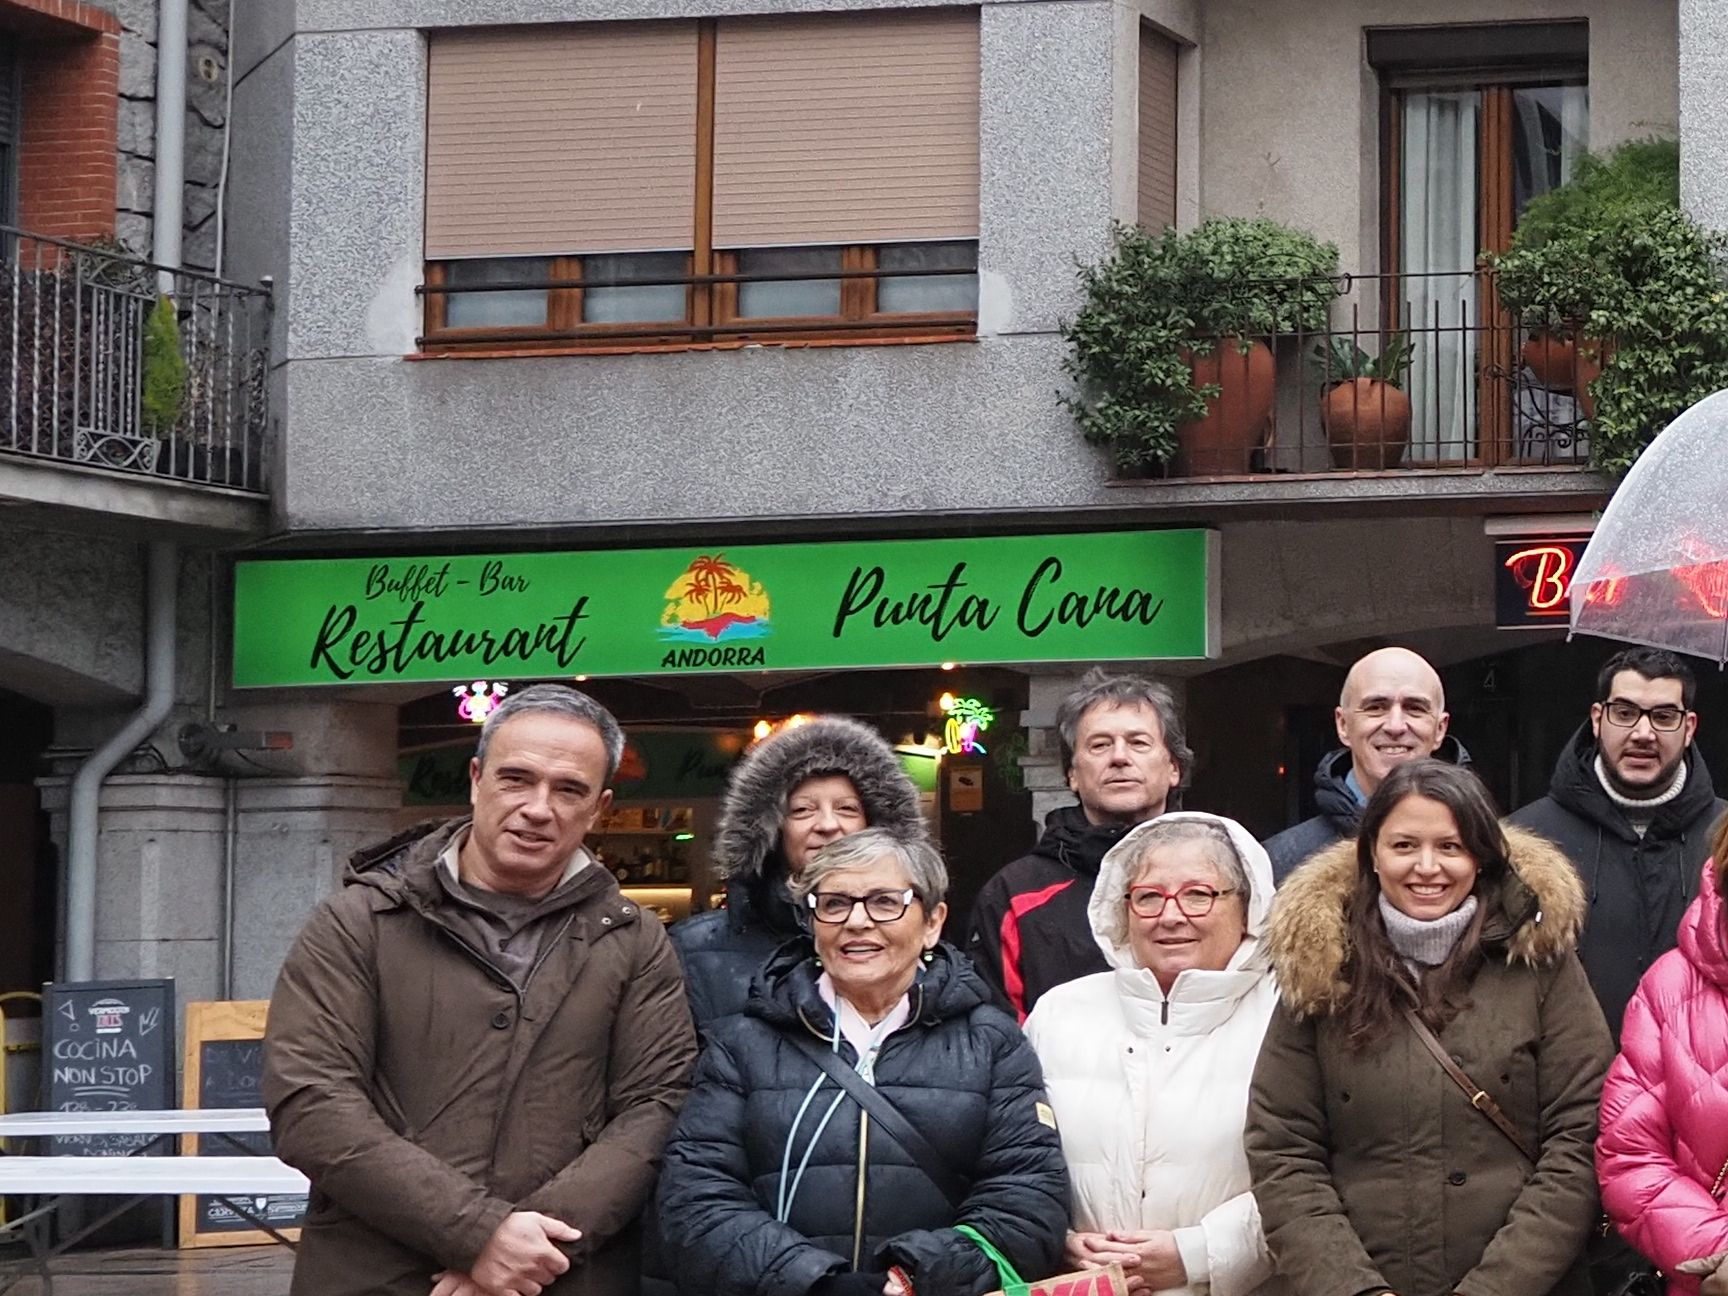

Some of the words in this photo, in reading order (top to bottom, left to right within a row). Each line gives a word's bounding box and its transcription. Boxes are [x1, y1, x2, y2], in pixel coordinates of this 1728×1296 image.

[365, 562, 451, 603] Buffet
[479, 560, 530, 597] Bar
[832, 561, 1001, 640] Punta
[1016, 556, 1164, 638] Cana
[309, 595, 590, 680] Restaurant
[661, 646, 765, 668] ANDORRA
[53, 1066, 96, 1086] NON
[100, 1064, 152, 1086] STOP
